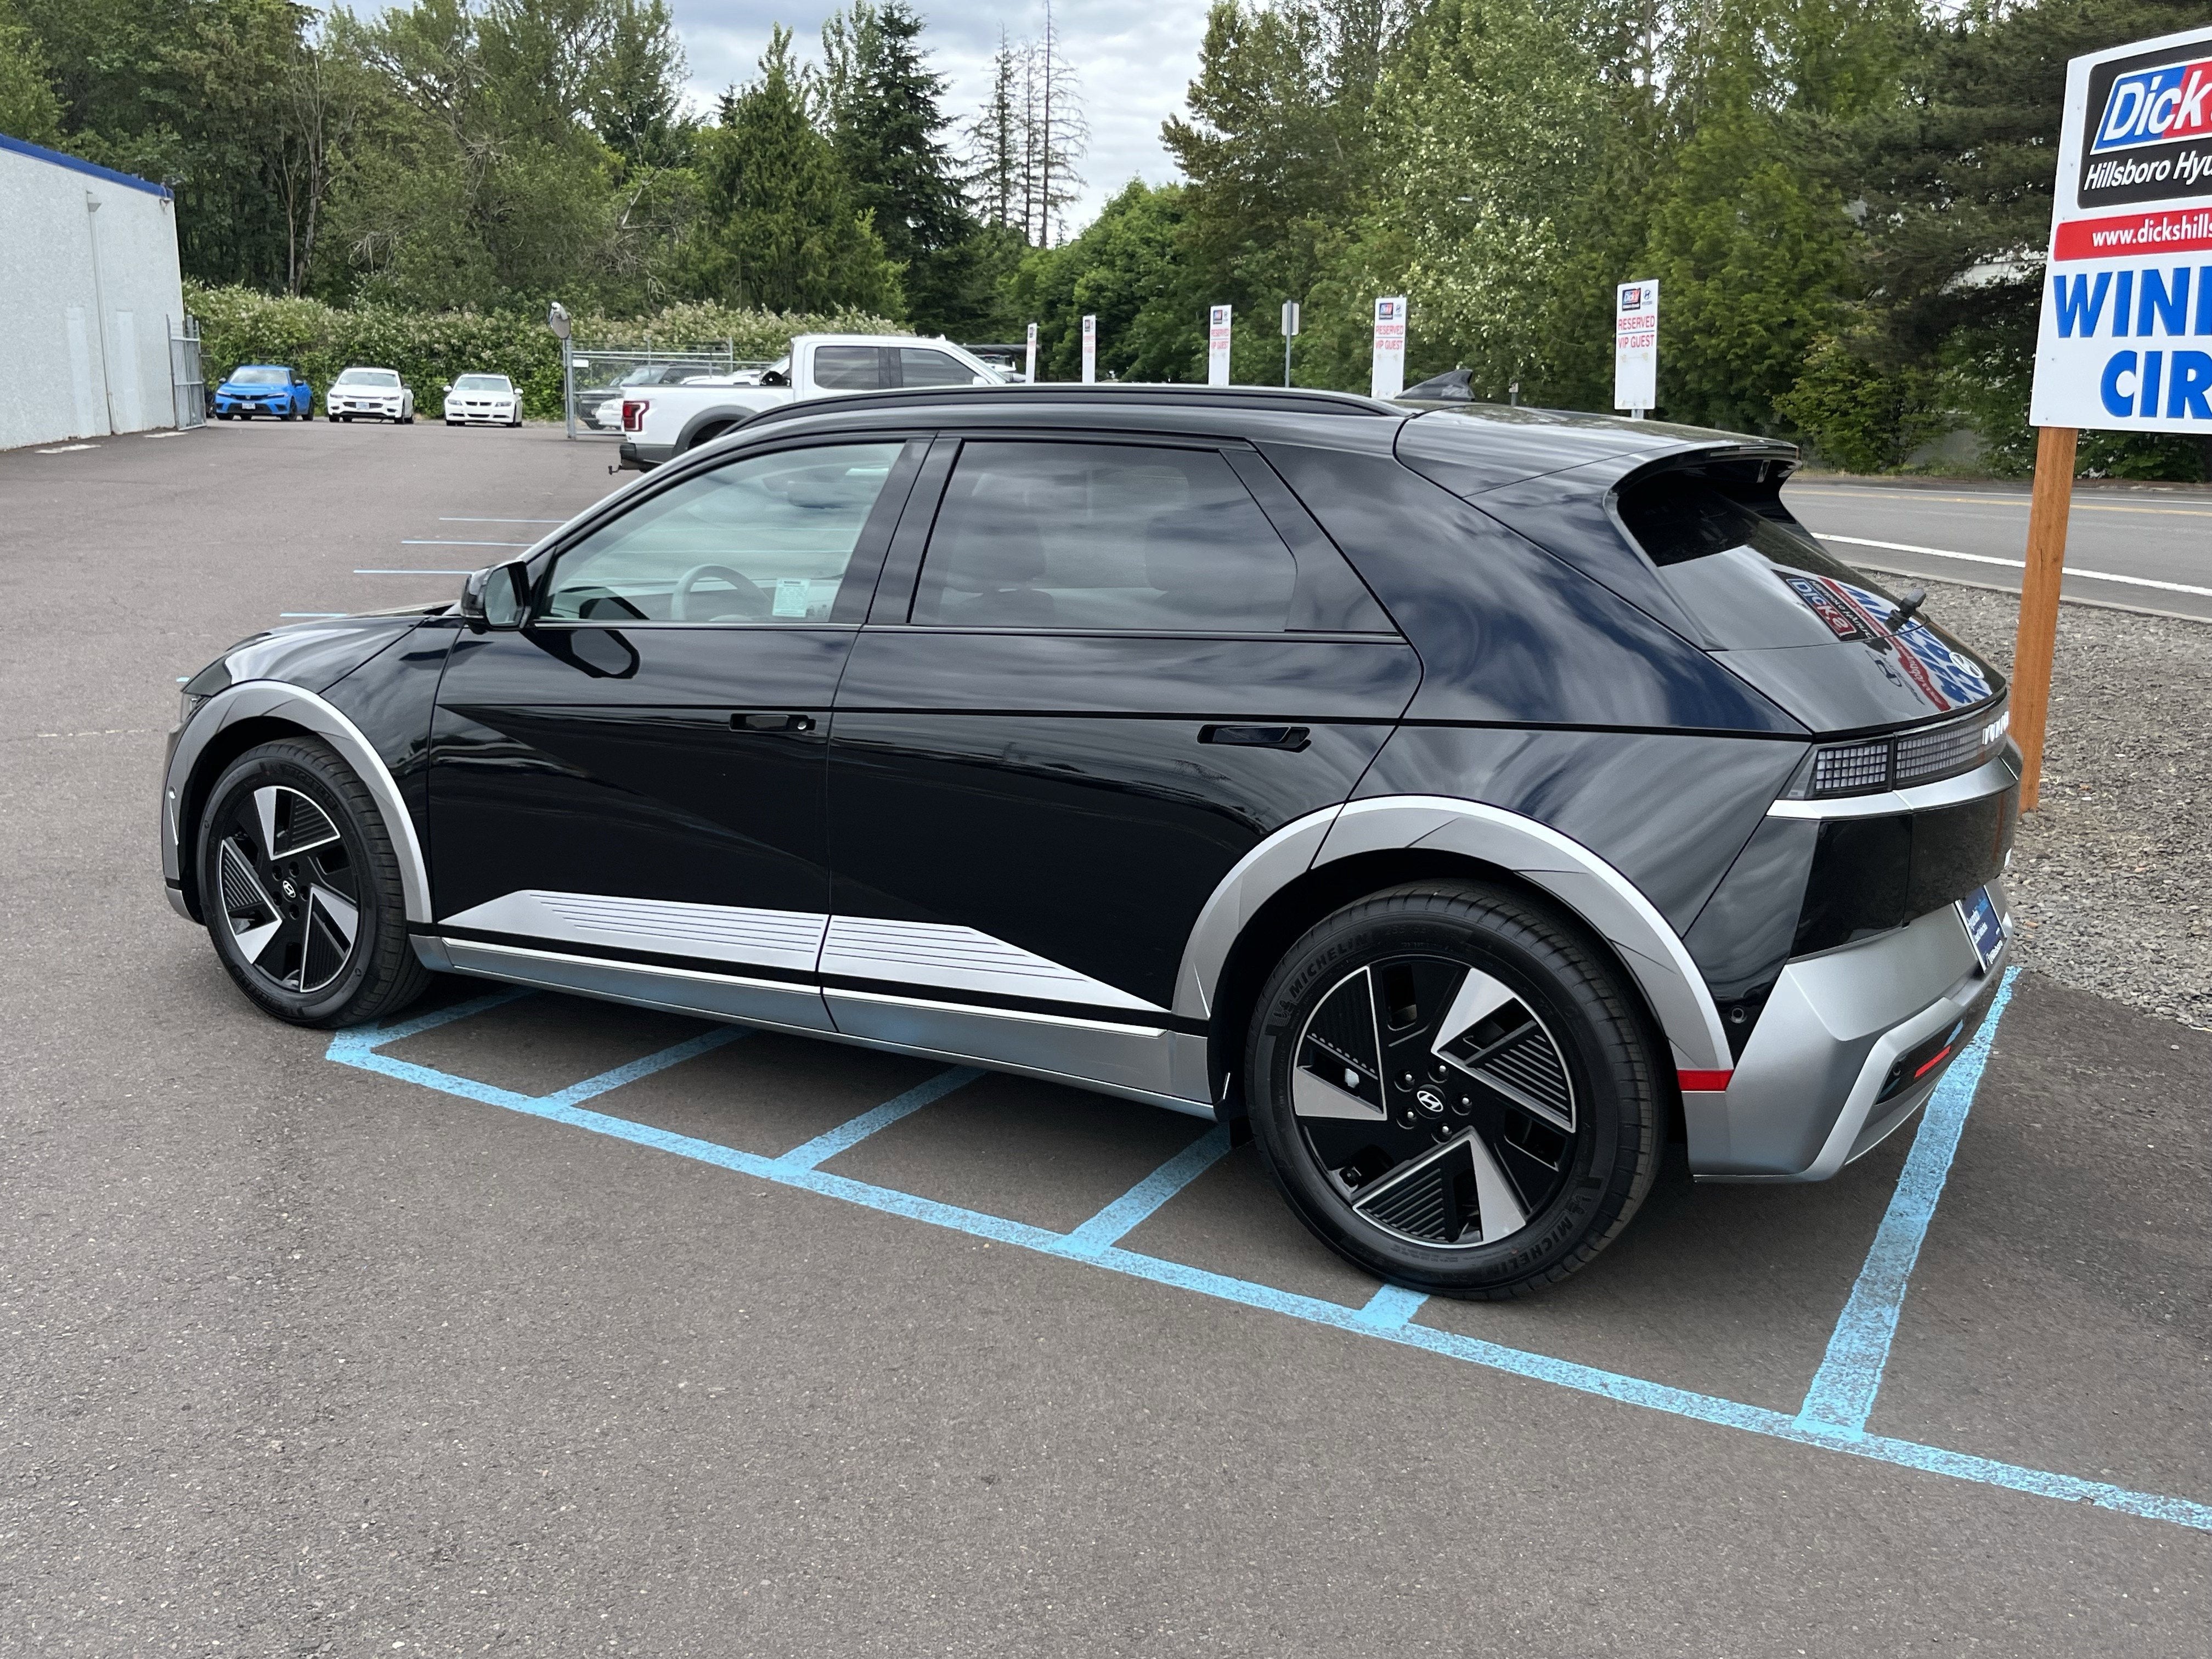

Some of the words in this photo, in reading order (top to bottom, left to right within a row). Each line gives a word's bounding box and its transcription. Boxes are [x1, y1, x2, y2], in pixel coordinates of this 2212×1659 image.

[2102, 70, 2212, 141] Dick
[2084, 159, 2171, 190] Hillsboro
[1375, 325, 1403, 335] RESERVED
[1618, 315, 1655, 330] RESERVED
[1385, 340, 1403, 349] GUEST
[1618, 336, 1629, 348] VIP
[1630, 335, 1655, 348] GUEST
[2100, 350, 2212, 419] CIR
[1289, 933, 1367, 998] MICHELIN
